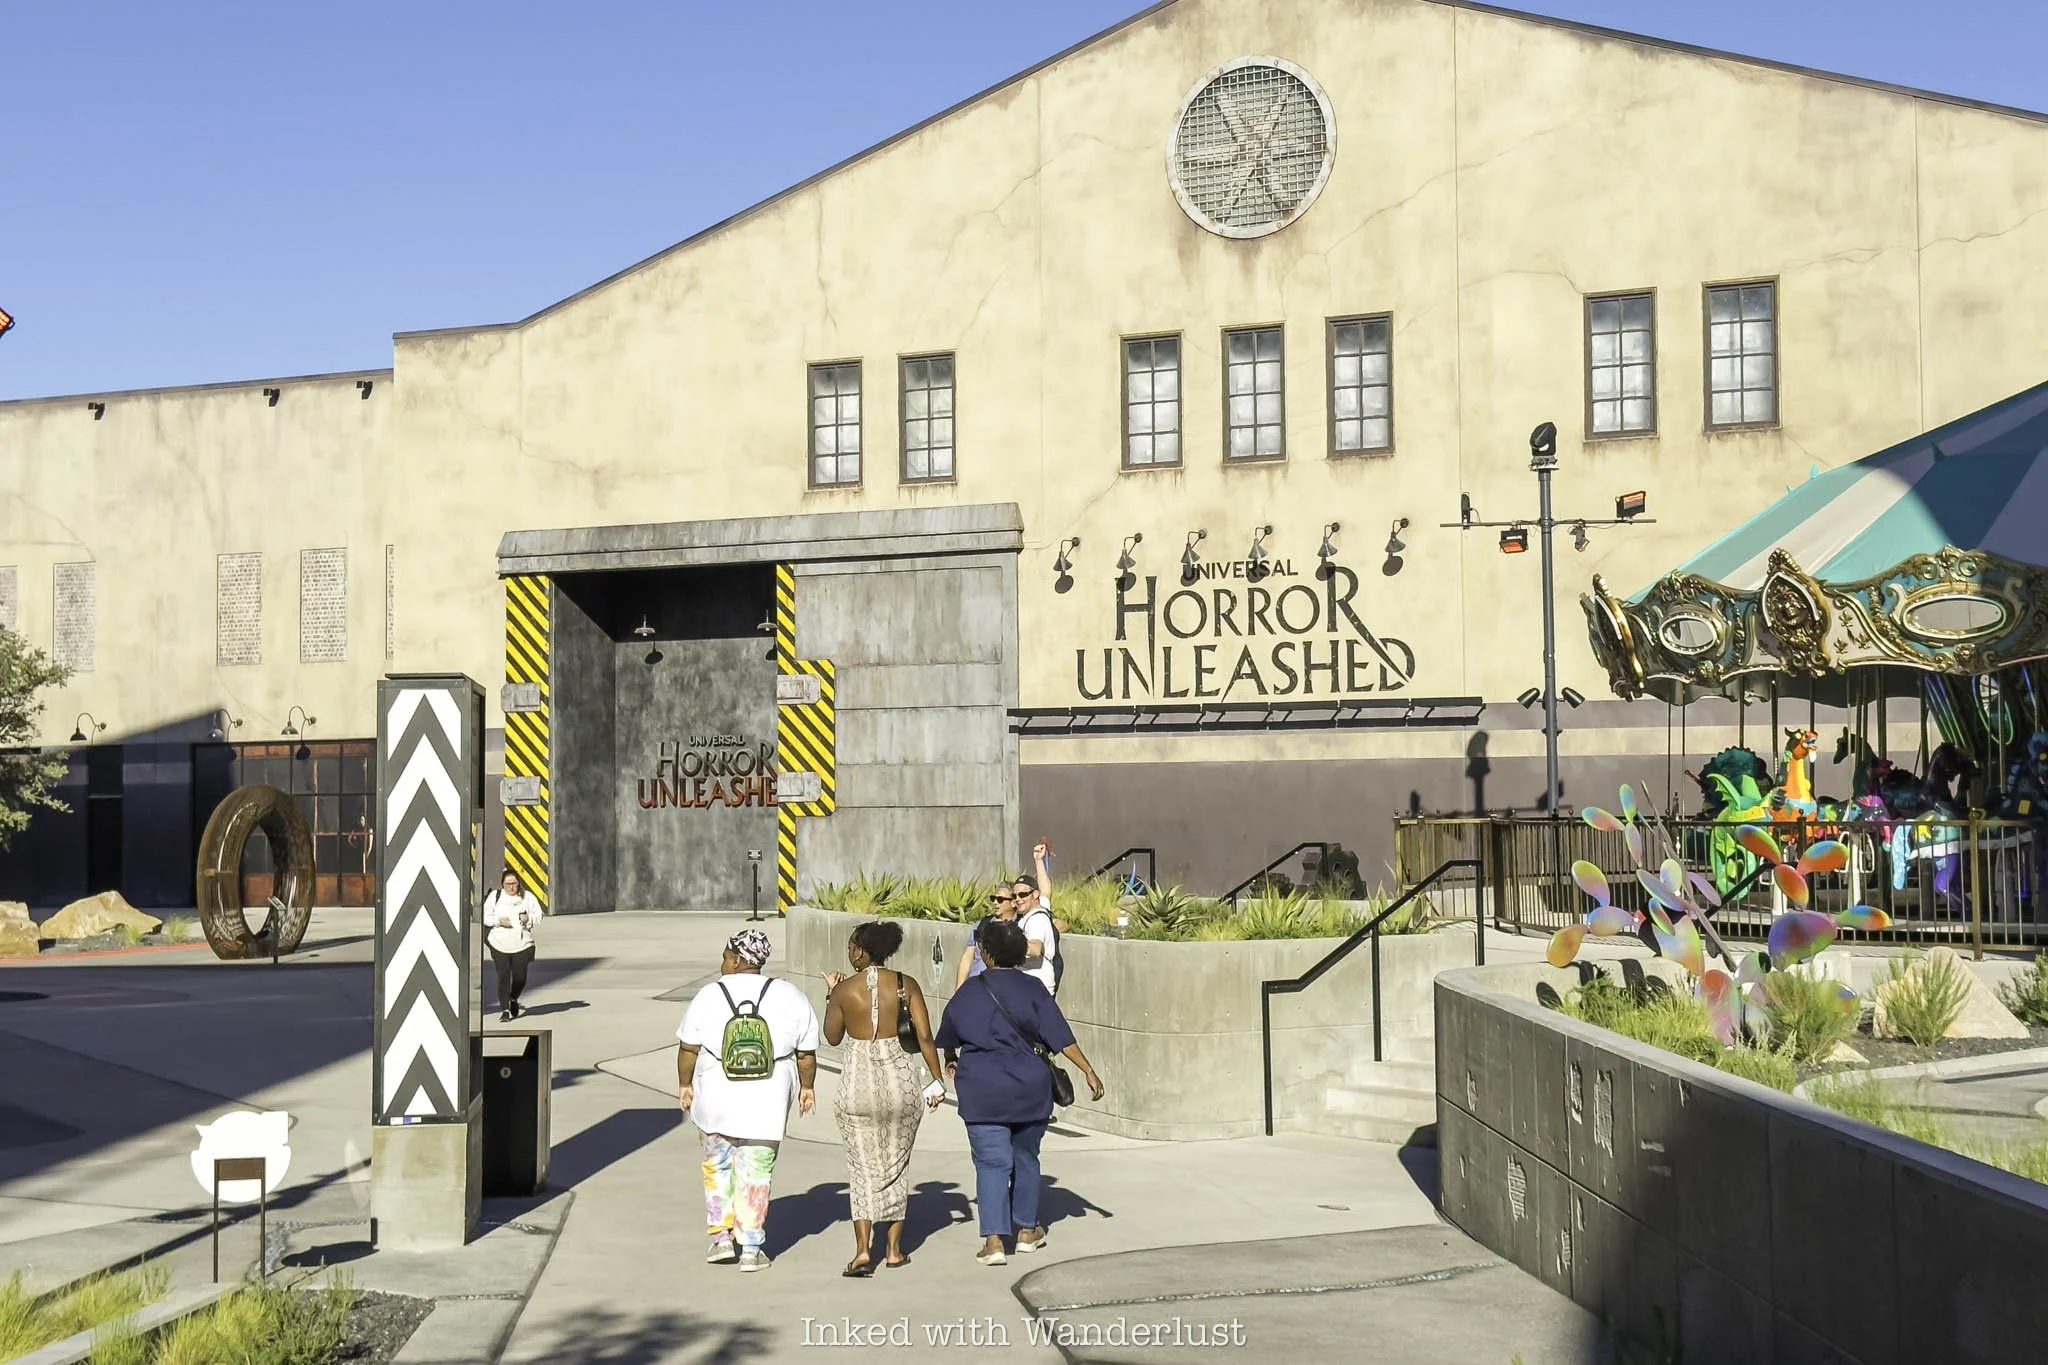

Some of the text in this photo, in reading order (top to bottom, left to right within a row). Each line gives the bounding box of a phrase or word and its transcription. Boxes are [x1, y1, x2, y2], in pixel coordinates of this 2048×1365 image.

[1182, 559, 1298, 581] UNIVERSAL
[1076, 637, 1416, 702] UNLEASHED
[689, 735, 746, 747] UNIVERSAL
[656, 740, 778, 807] HORROR
[637, 777, 778, 809] UNLEASHE
